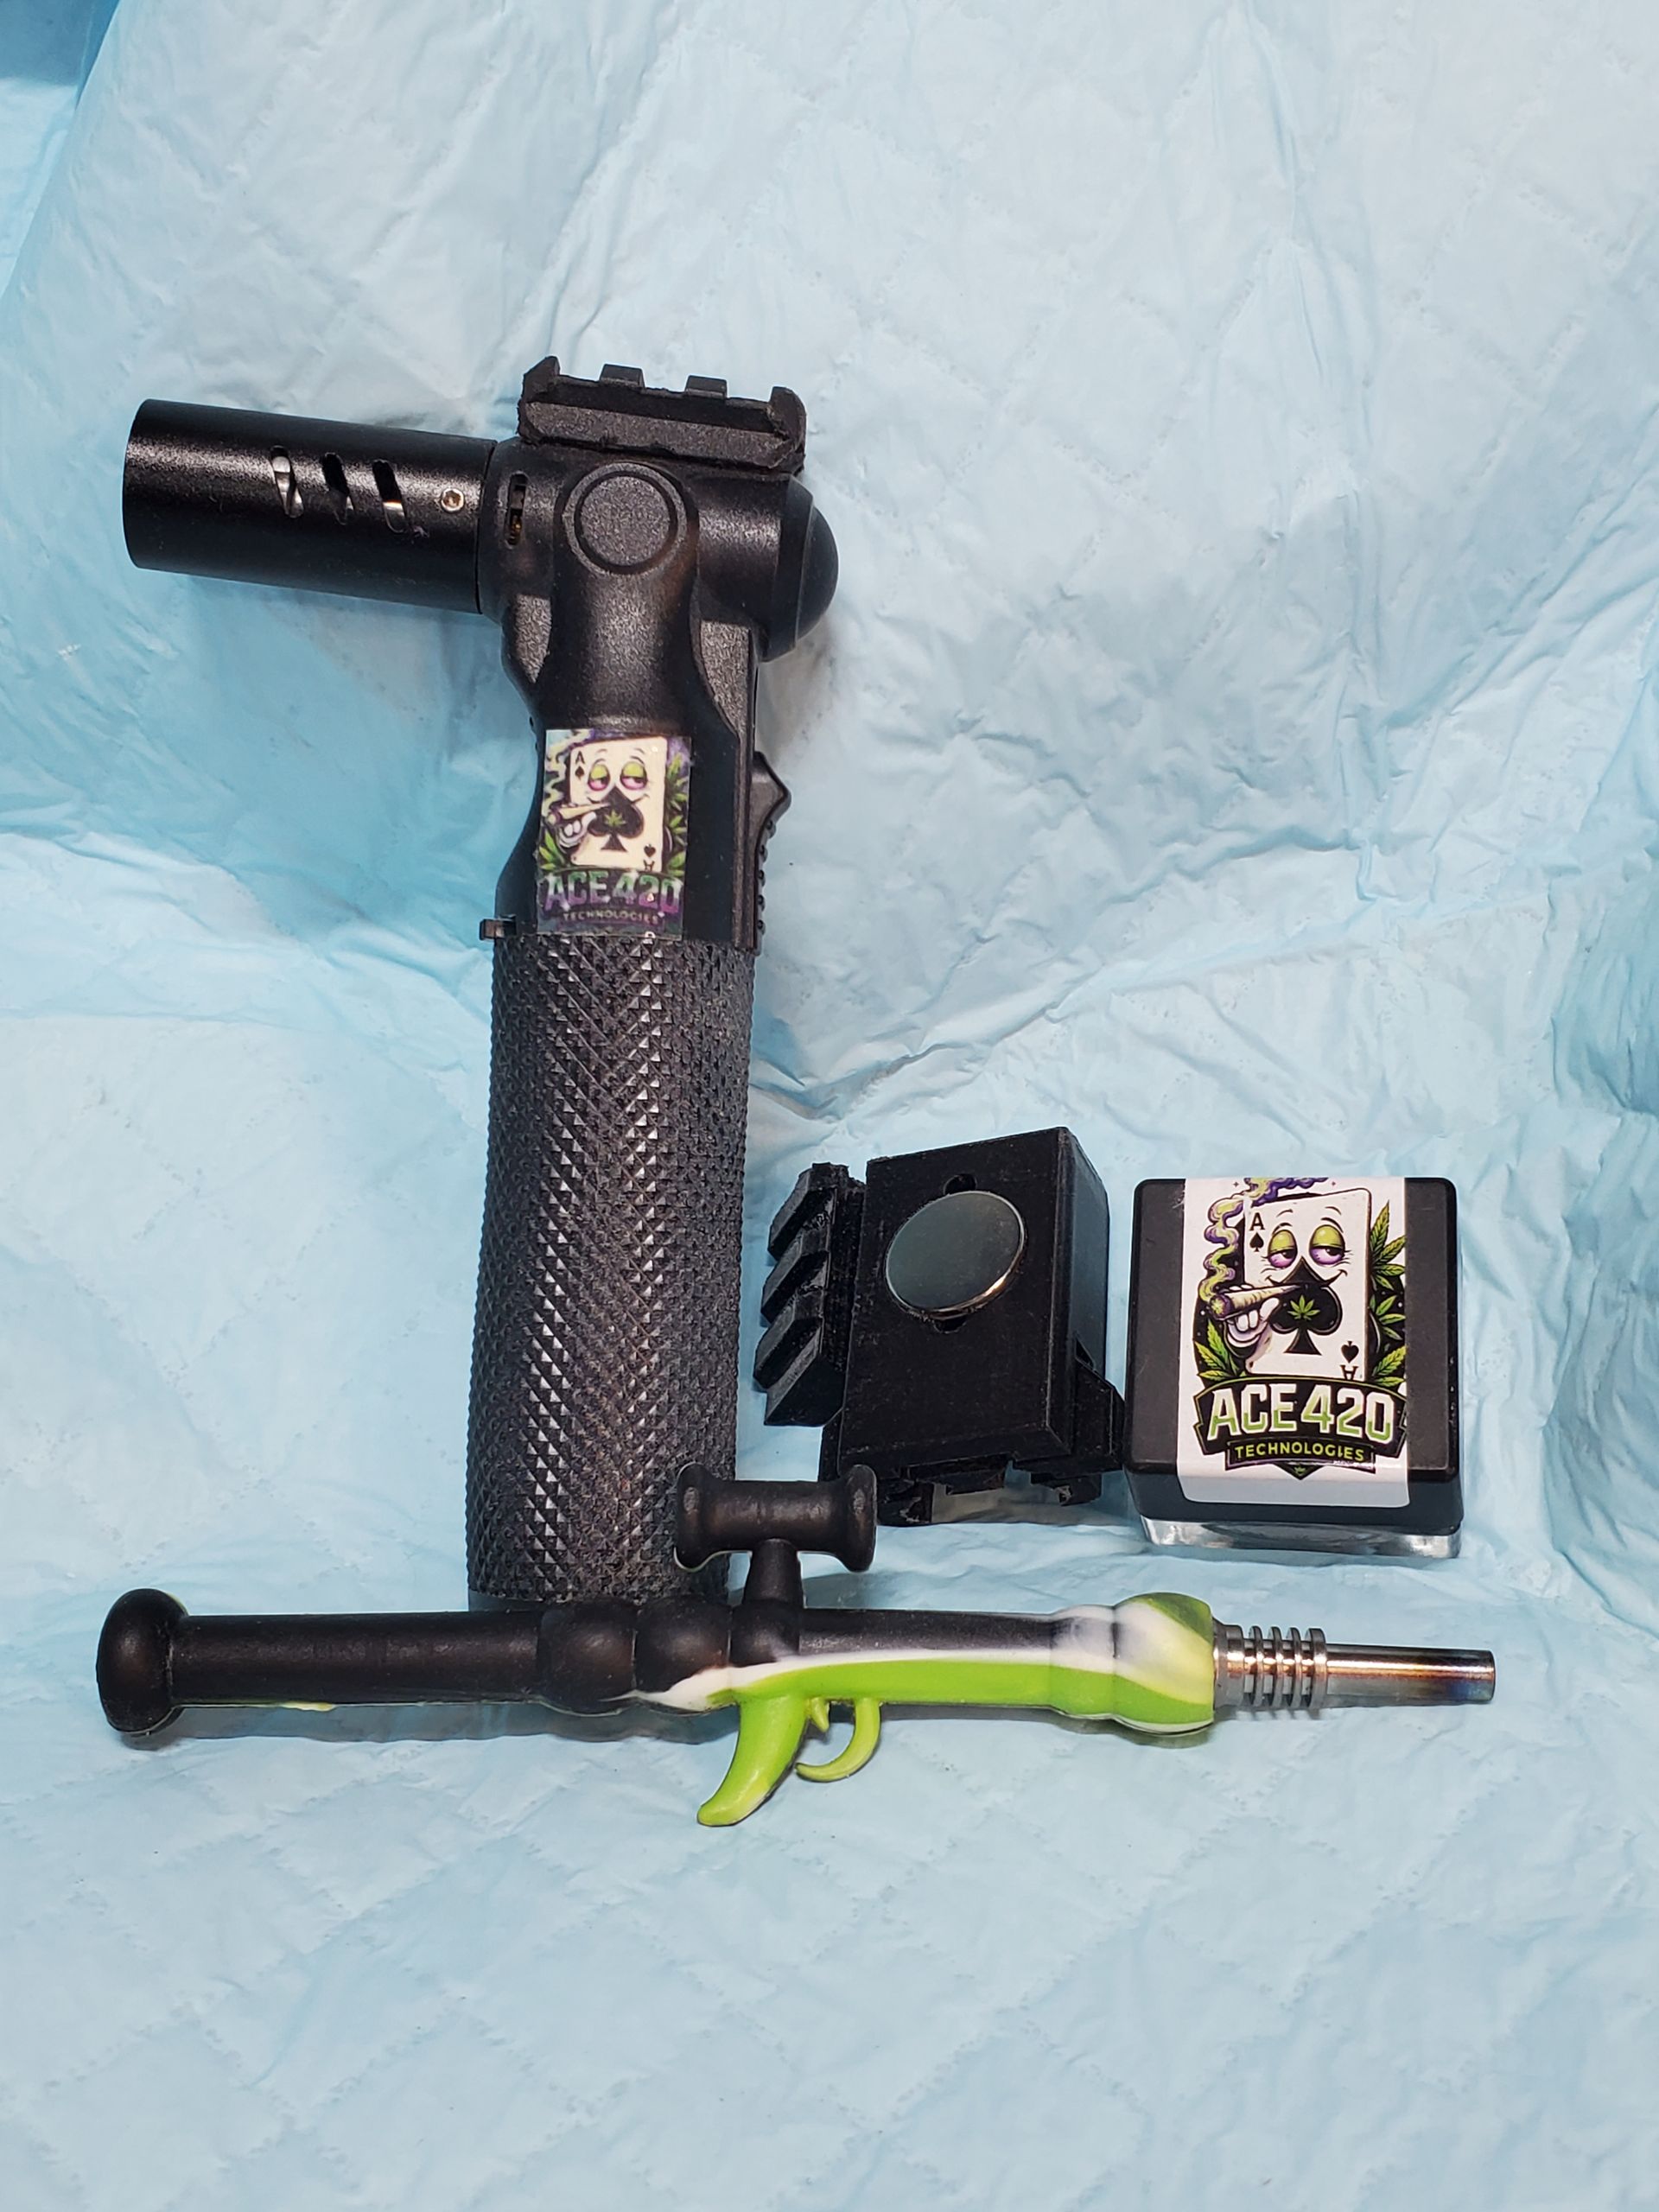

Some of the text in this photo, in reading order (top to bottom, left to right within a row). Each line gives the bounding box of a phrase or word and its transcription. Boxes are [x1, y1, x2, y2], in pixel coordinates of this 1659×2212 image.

[544, 871, 683, 914] ACE 420
[563, 909, 659, 925] TECHNOLOGIES
[1249, 1211, 1266, 1231] A
[1206, 1382, 1395, 1444] ACE 420
[1234, 1441, 1365, 1463] TECHNOLOGIES
